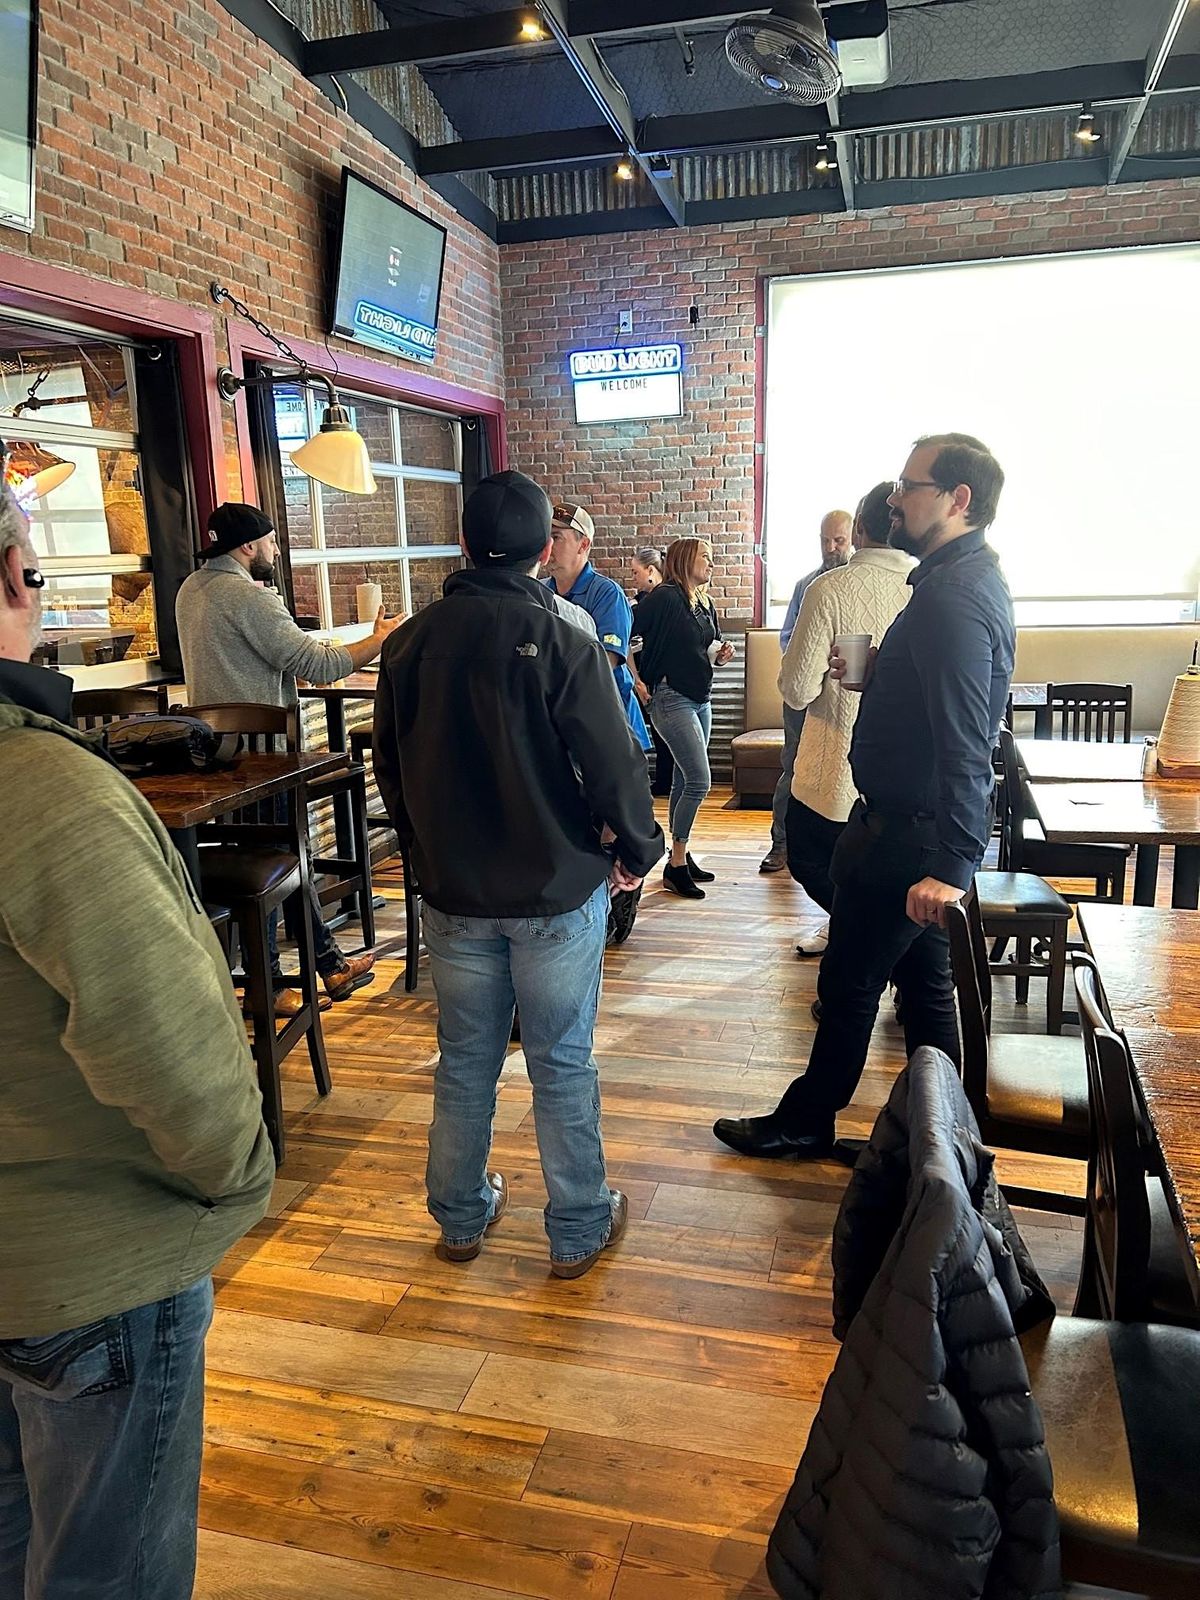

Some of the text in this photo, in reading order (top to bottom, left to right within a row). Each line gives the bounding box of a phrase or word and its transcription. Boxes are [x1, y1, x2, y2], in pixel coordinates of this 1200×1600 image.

[574, 349, 677, 374] BUD LIGHT
[600, 378, 648, 391] WELCOME
